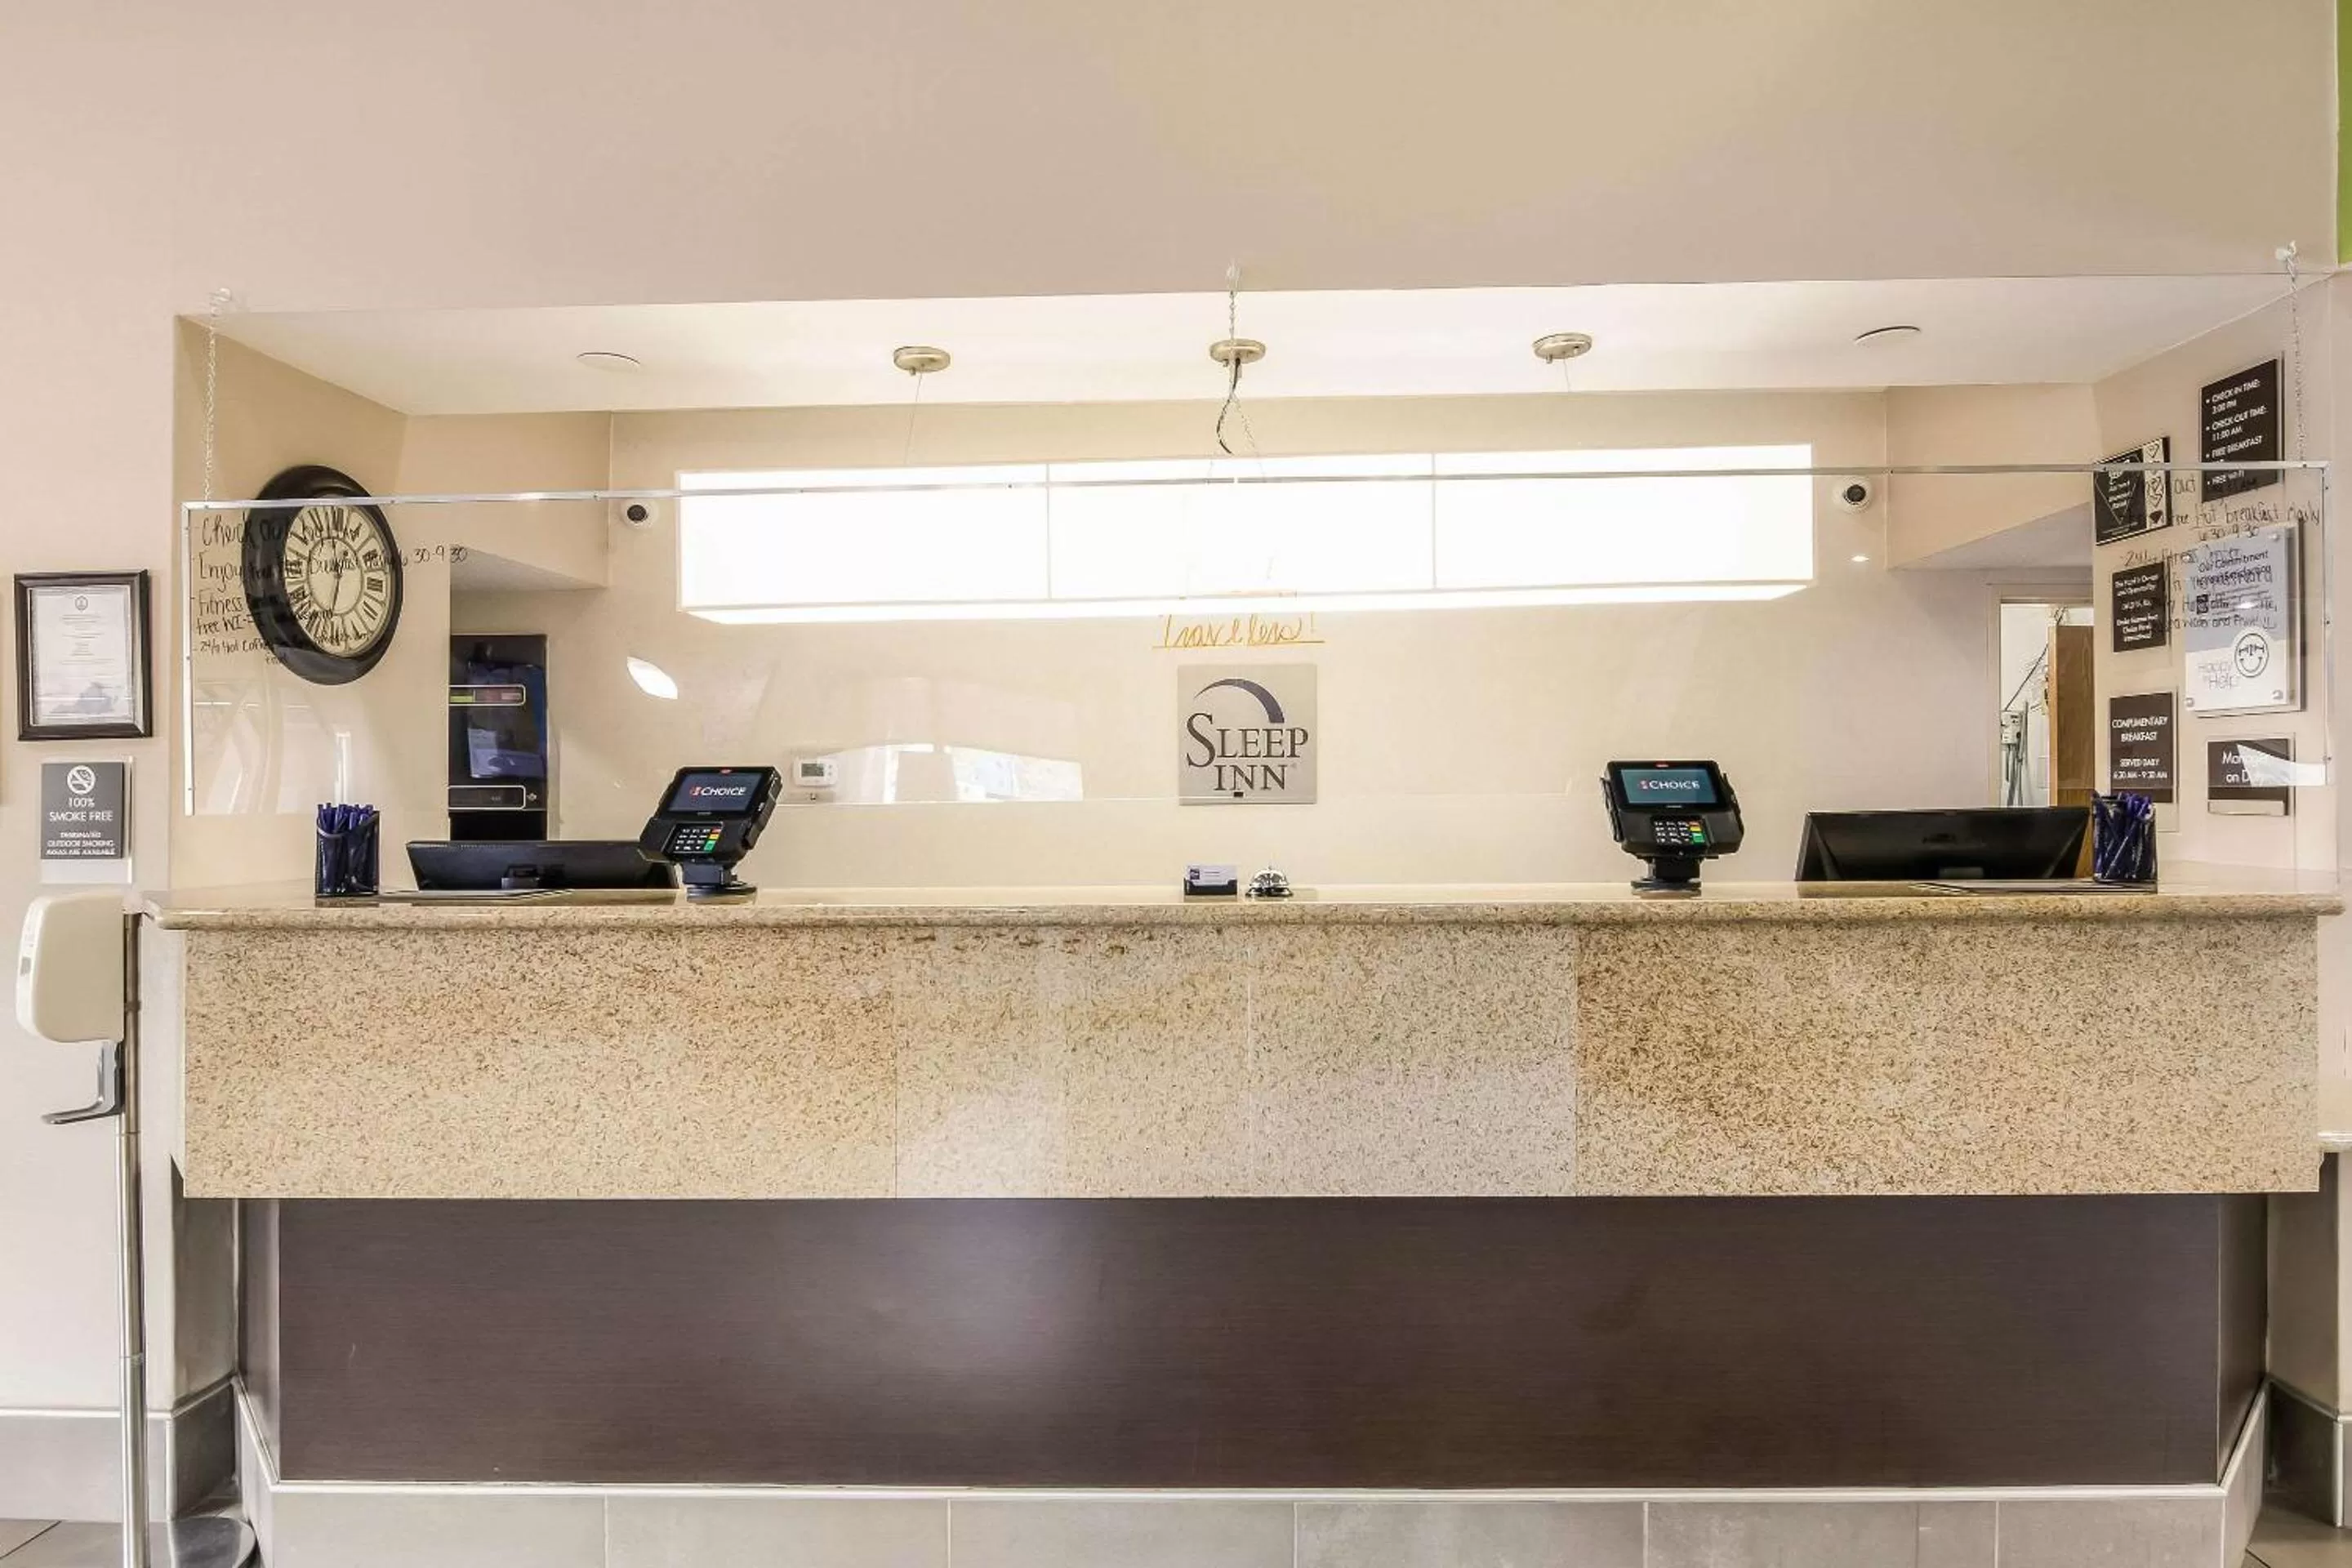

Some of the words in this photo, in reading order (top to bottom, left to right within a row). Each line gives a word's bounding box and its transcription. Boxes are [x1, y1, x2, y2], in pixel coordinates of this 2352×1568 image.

[1649, 780, 1700, 790] CHOICE
[700, 786, 747, 796] CHOICE
[68, 797, 96, 808] 100%
[49, 811, 87, 822] SMOKE
[88, 811, 114, 822] FREE
